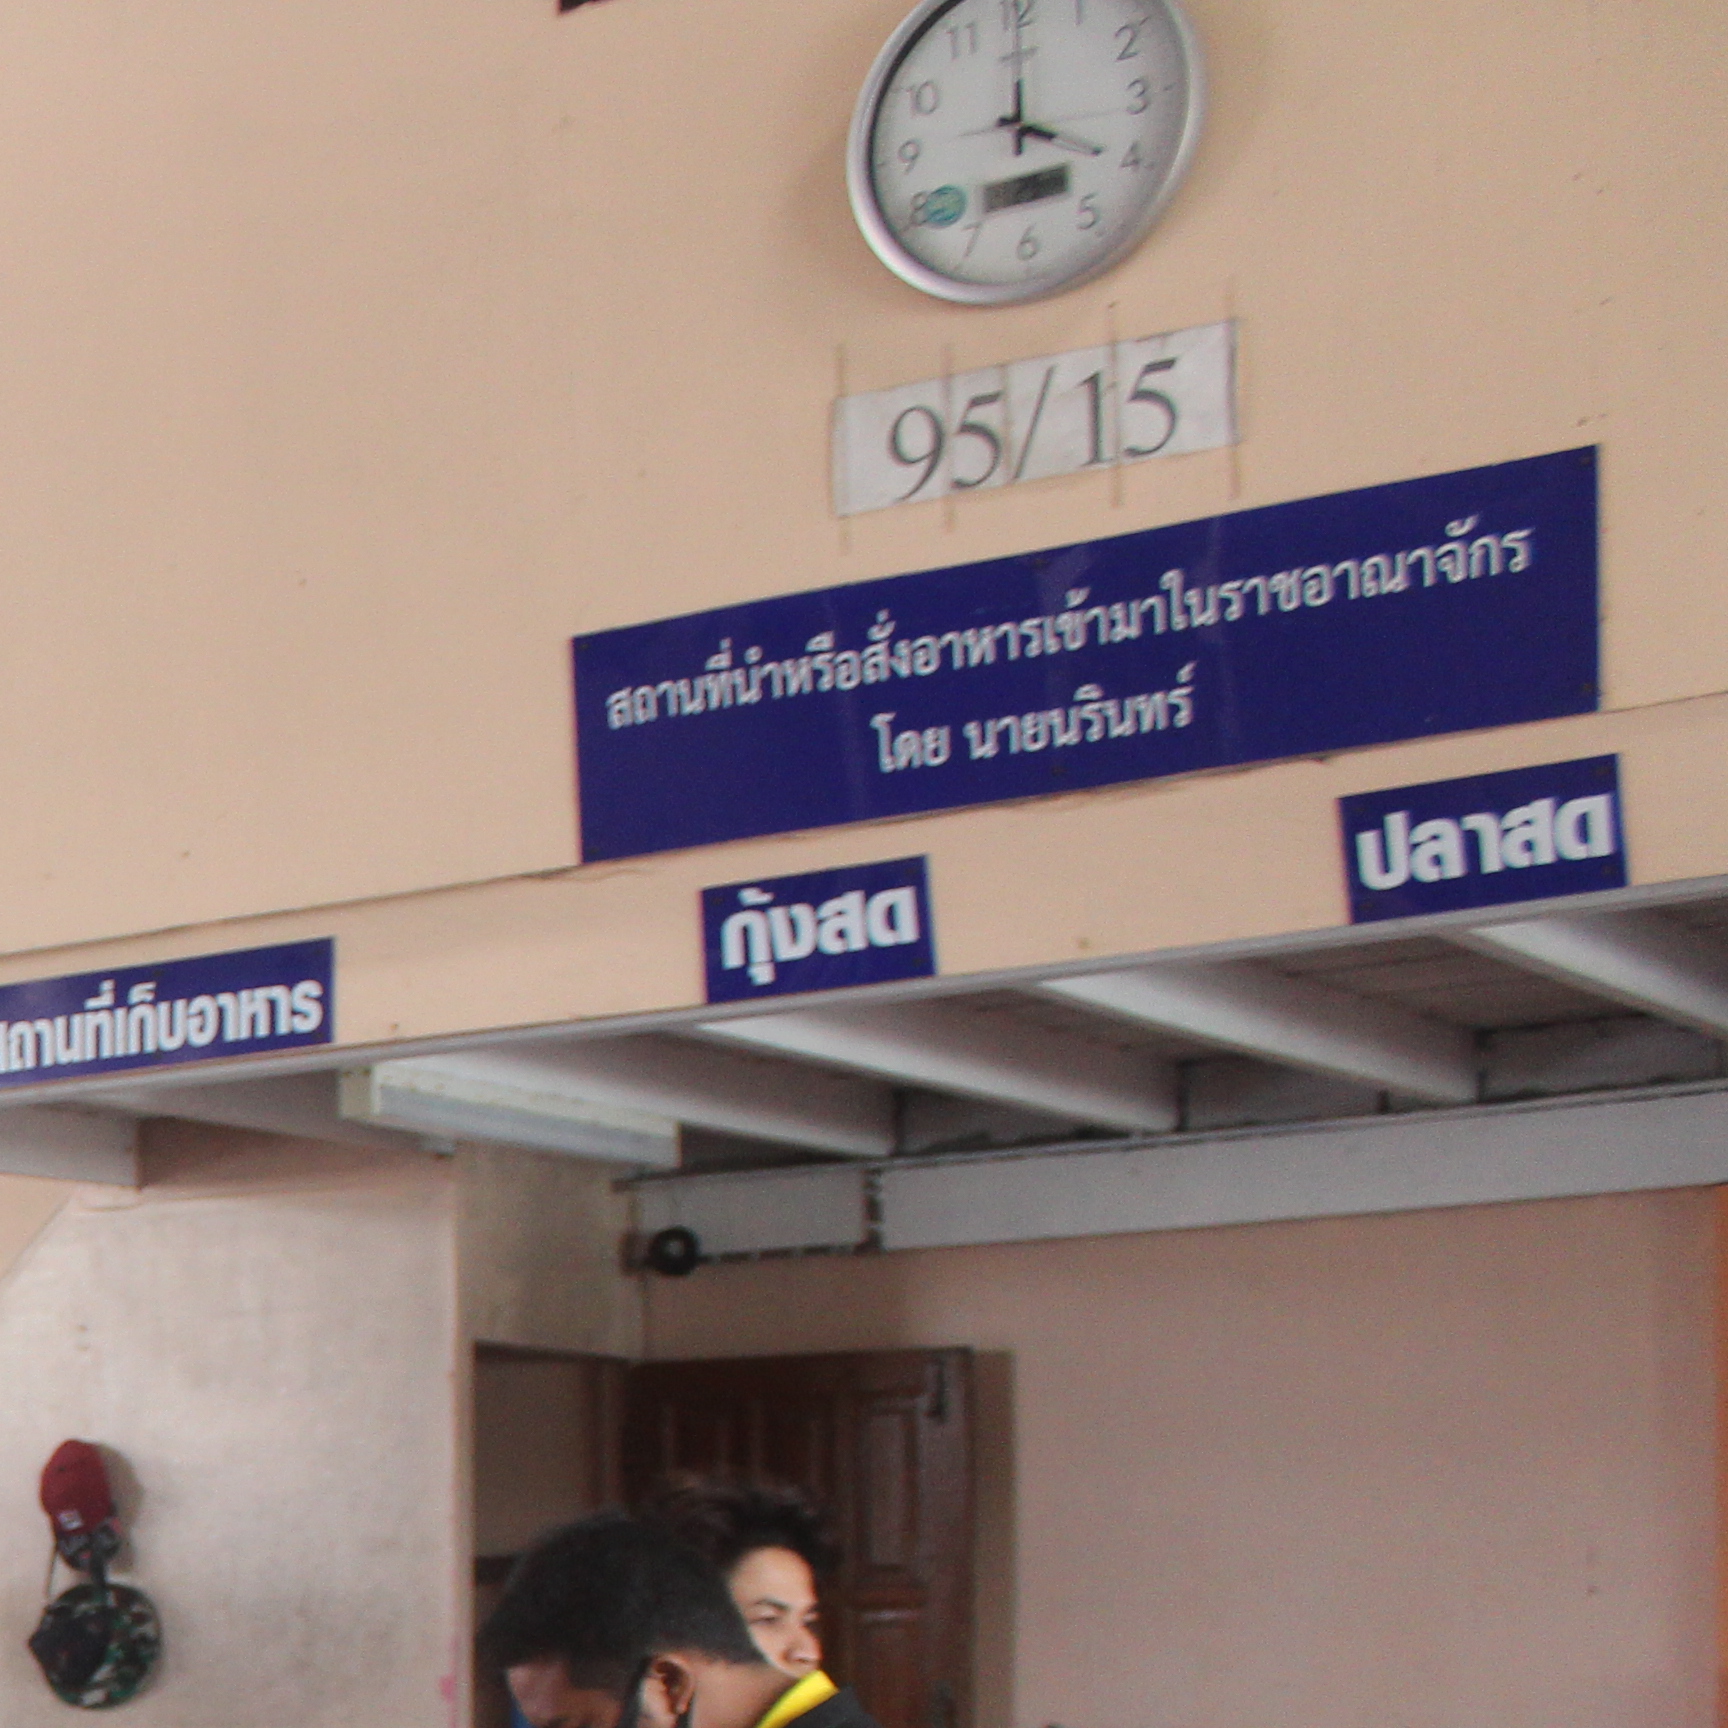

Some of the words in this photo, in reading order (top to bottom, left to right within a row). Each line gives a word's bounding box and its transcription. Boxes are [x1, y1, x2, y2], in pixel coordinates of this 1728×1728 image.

[946, 22, 980, 61] 11
[1113, 23, 1142, 62] 2
[905, 79, 940, 116] 10
[1125, 77, 1151, 116] 3
[897, 138, 922, 176] 9
[1118, 140, 1145, 172] 4
[1076, 193, 1101, 231] 5
[961, 219, 988, 259] 7
[1015, 224, 1039, 262] 6
[888, 356, 1179, 502] 95/15
[605, 514, 1536, 731] สถานที่นำหรือสั่งอาหารเข้ามาในราชอาณาจักร
[871, 714, 951, 775] โดย
[963, 661, 1197, 761] นายนรินทร์
[1355, 793, 1615, 891] ปลาสด
[720, 886, 921, 986] กุ้งสด
